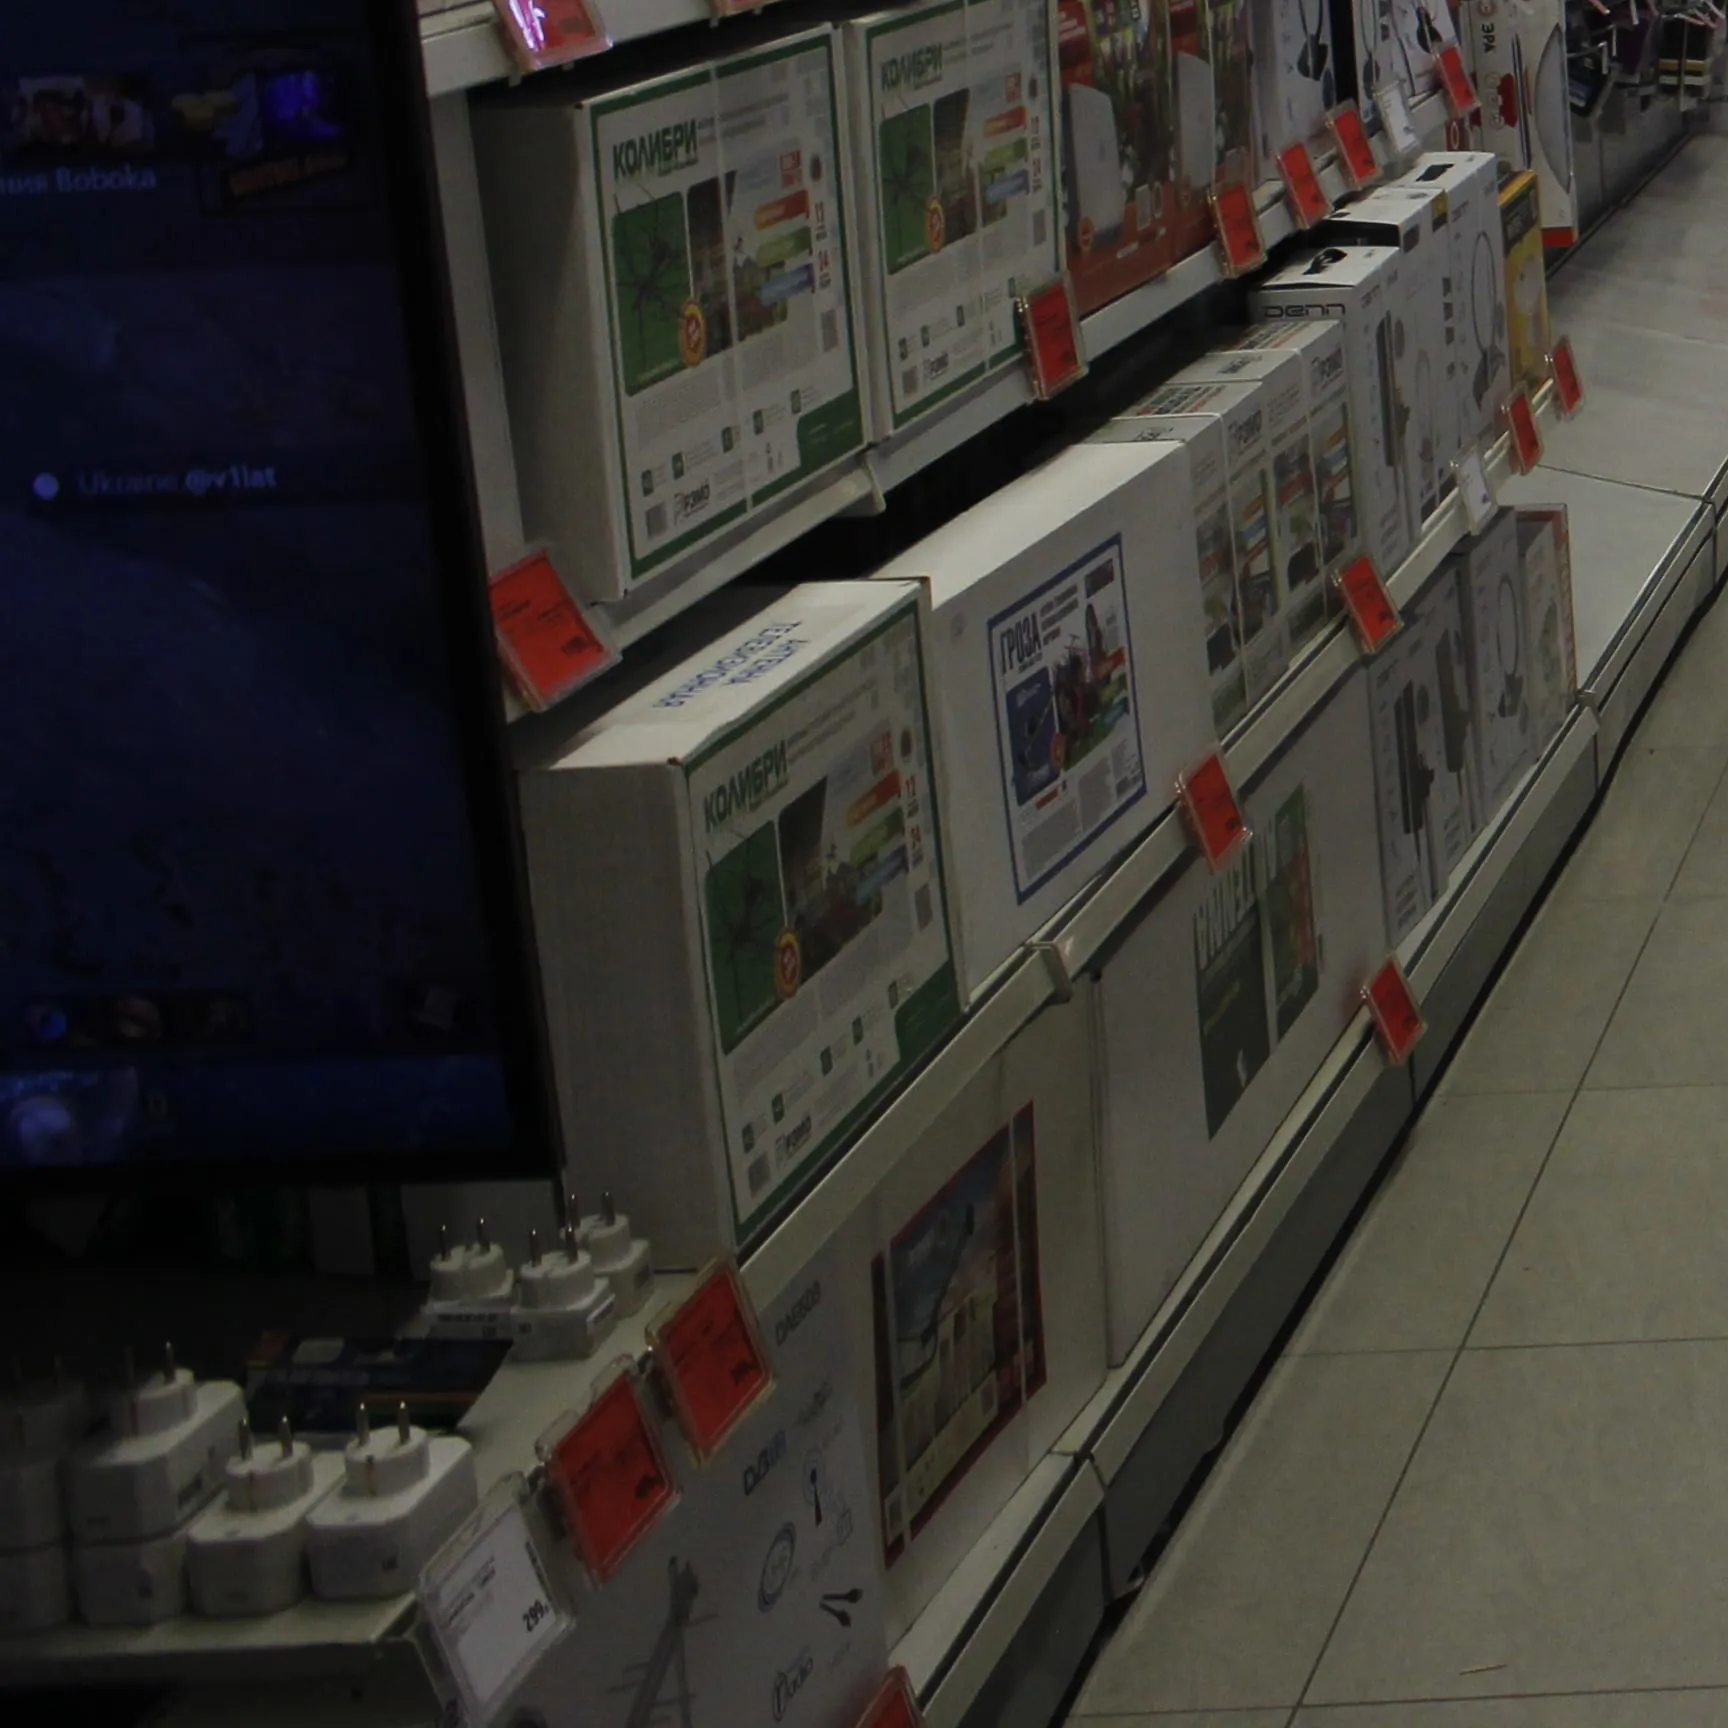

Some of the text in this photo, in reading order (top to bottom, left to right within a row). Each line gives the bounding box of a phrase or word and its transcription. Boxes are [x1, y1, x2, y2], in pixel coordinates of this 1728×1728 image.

[1481, 21, 1496, 54] ЭРА
[881, 42, 943, 90] КОЛИБРИ
[612, 117, 698, 178] КОЛИБРИ
[1263, 304, 1347, 319] DENN
[1000, 594, 1042, 675] ГРОЗА
[703, 738, 789, 834] КОЛИБРИ
